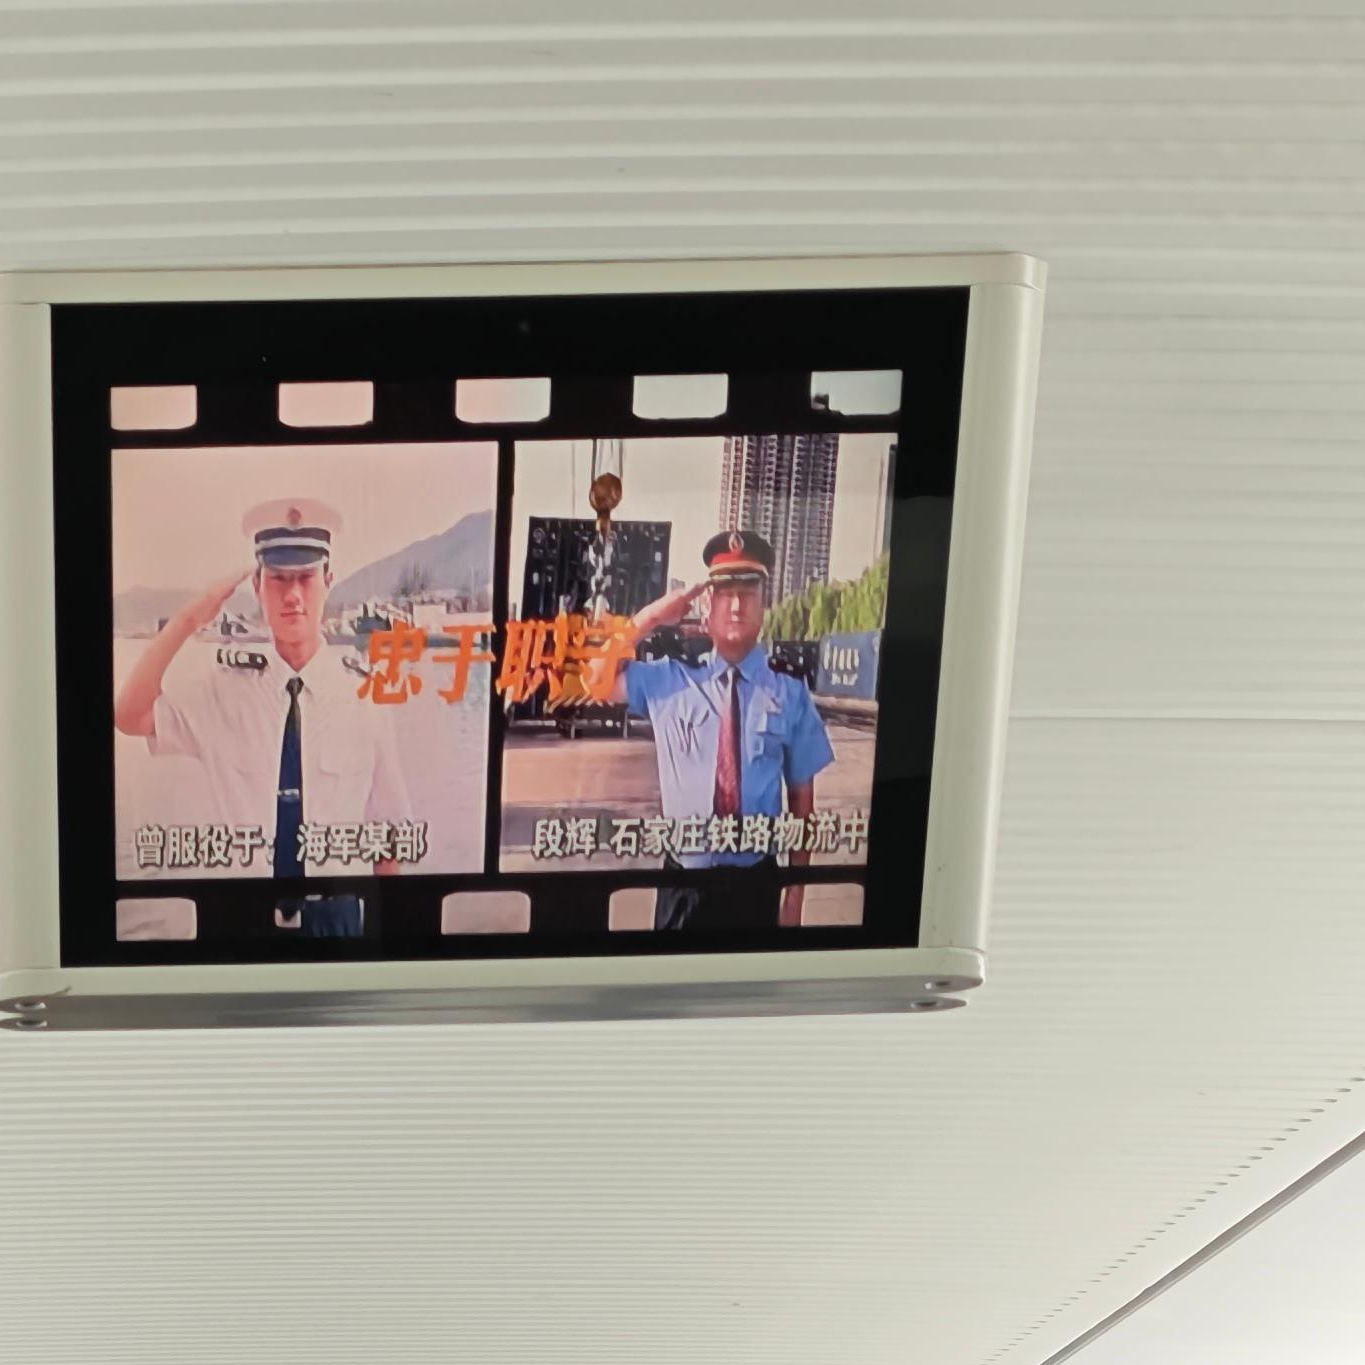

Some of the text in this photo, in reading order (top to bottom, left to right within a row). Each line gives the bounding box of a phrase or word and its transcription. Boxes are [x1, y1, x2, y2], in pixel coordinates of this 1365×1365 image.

[137, 821, 428, 868] 曾服役于海军某部
[609, 809, 869, 857] 石家庄铁路物流中
